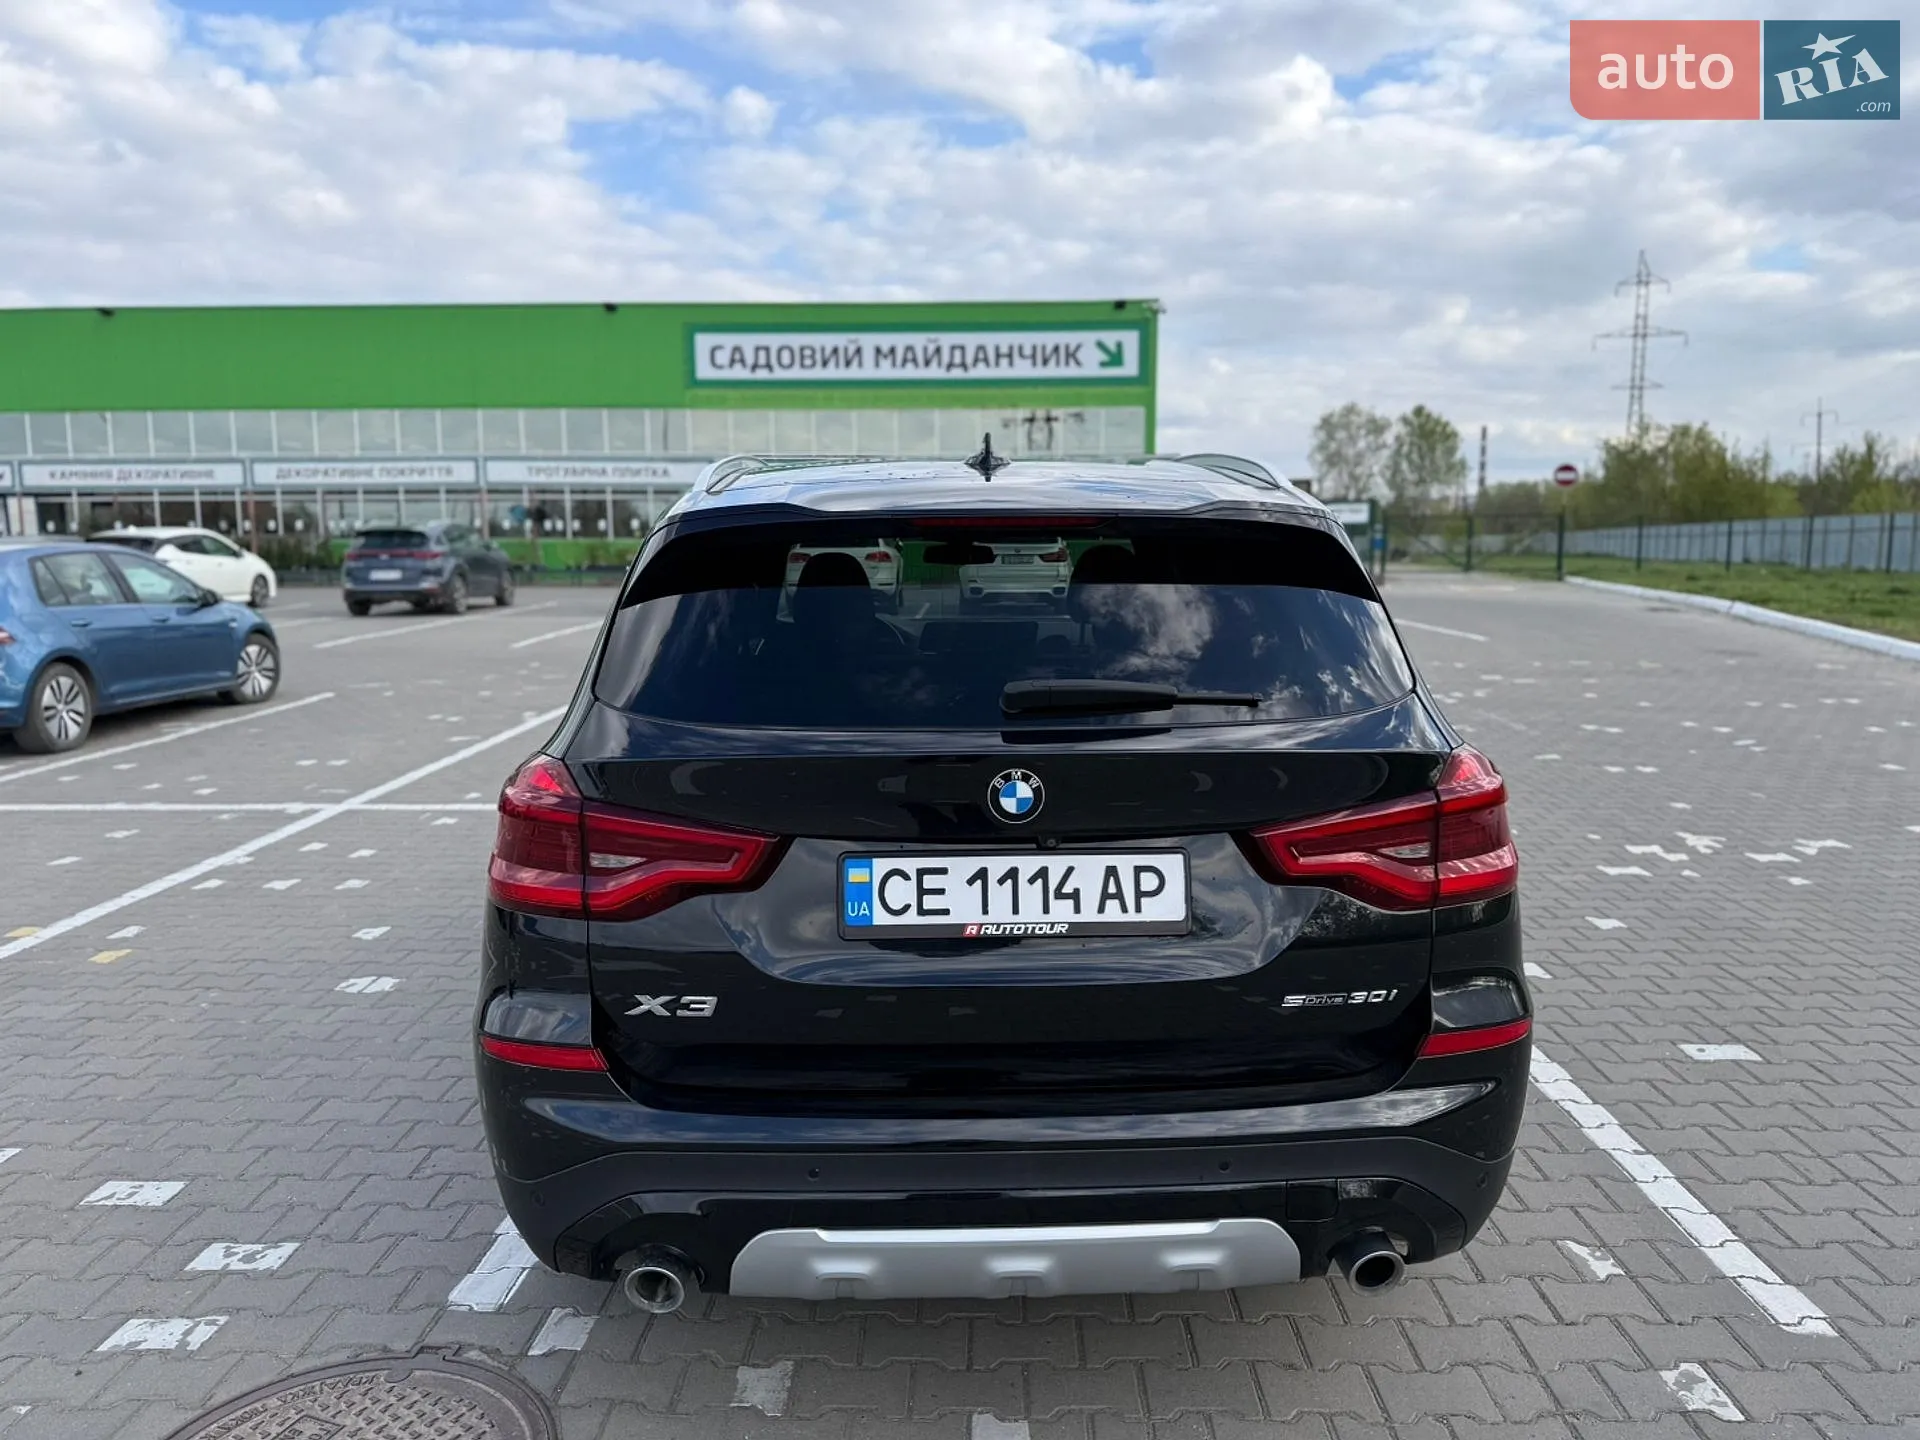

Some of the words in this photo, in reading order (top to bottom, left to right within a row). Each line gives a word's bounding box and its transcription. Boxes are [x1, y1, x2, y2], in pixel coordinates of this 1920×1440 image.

[709, 338, 864, 373] САДОВИЙ
[874, 336, 1083, 373] МАЙДАНЧИК
[878, 866, 951, 917] CE
[966, 865, 1081, 916] 1114
[1097, 864, 1166, 915] AP
[847, 901, 870, 917] UA
[980, 923, 1068, 936] AUTOTOUR
[624, 994, 719, 1017] X3
